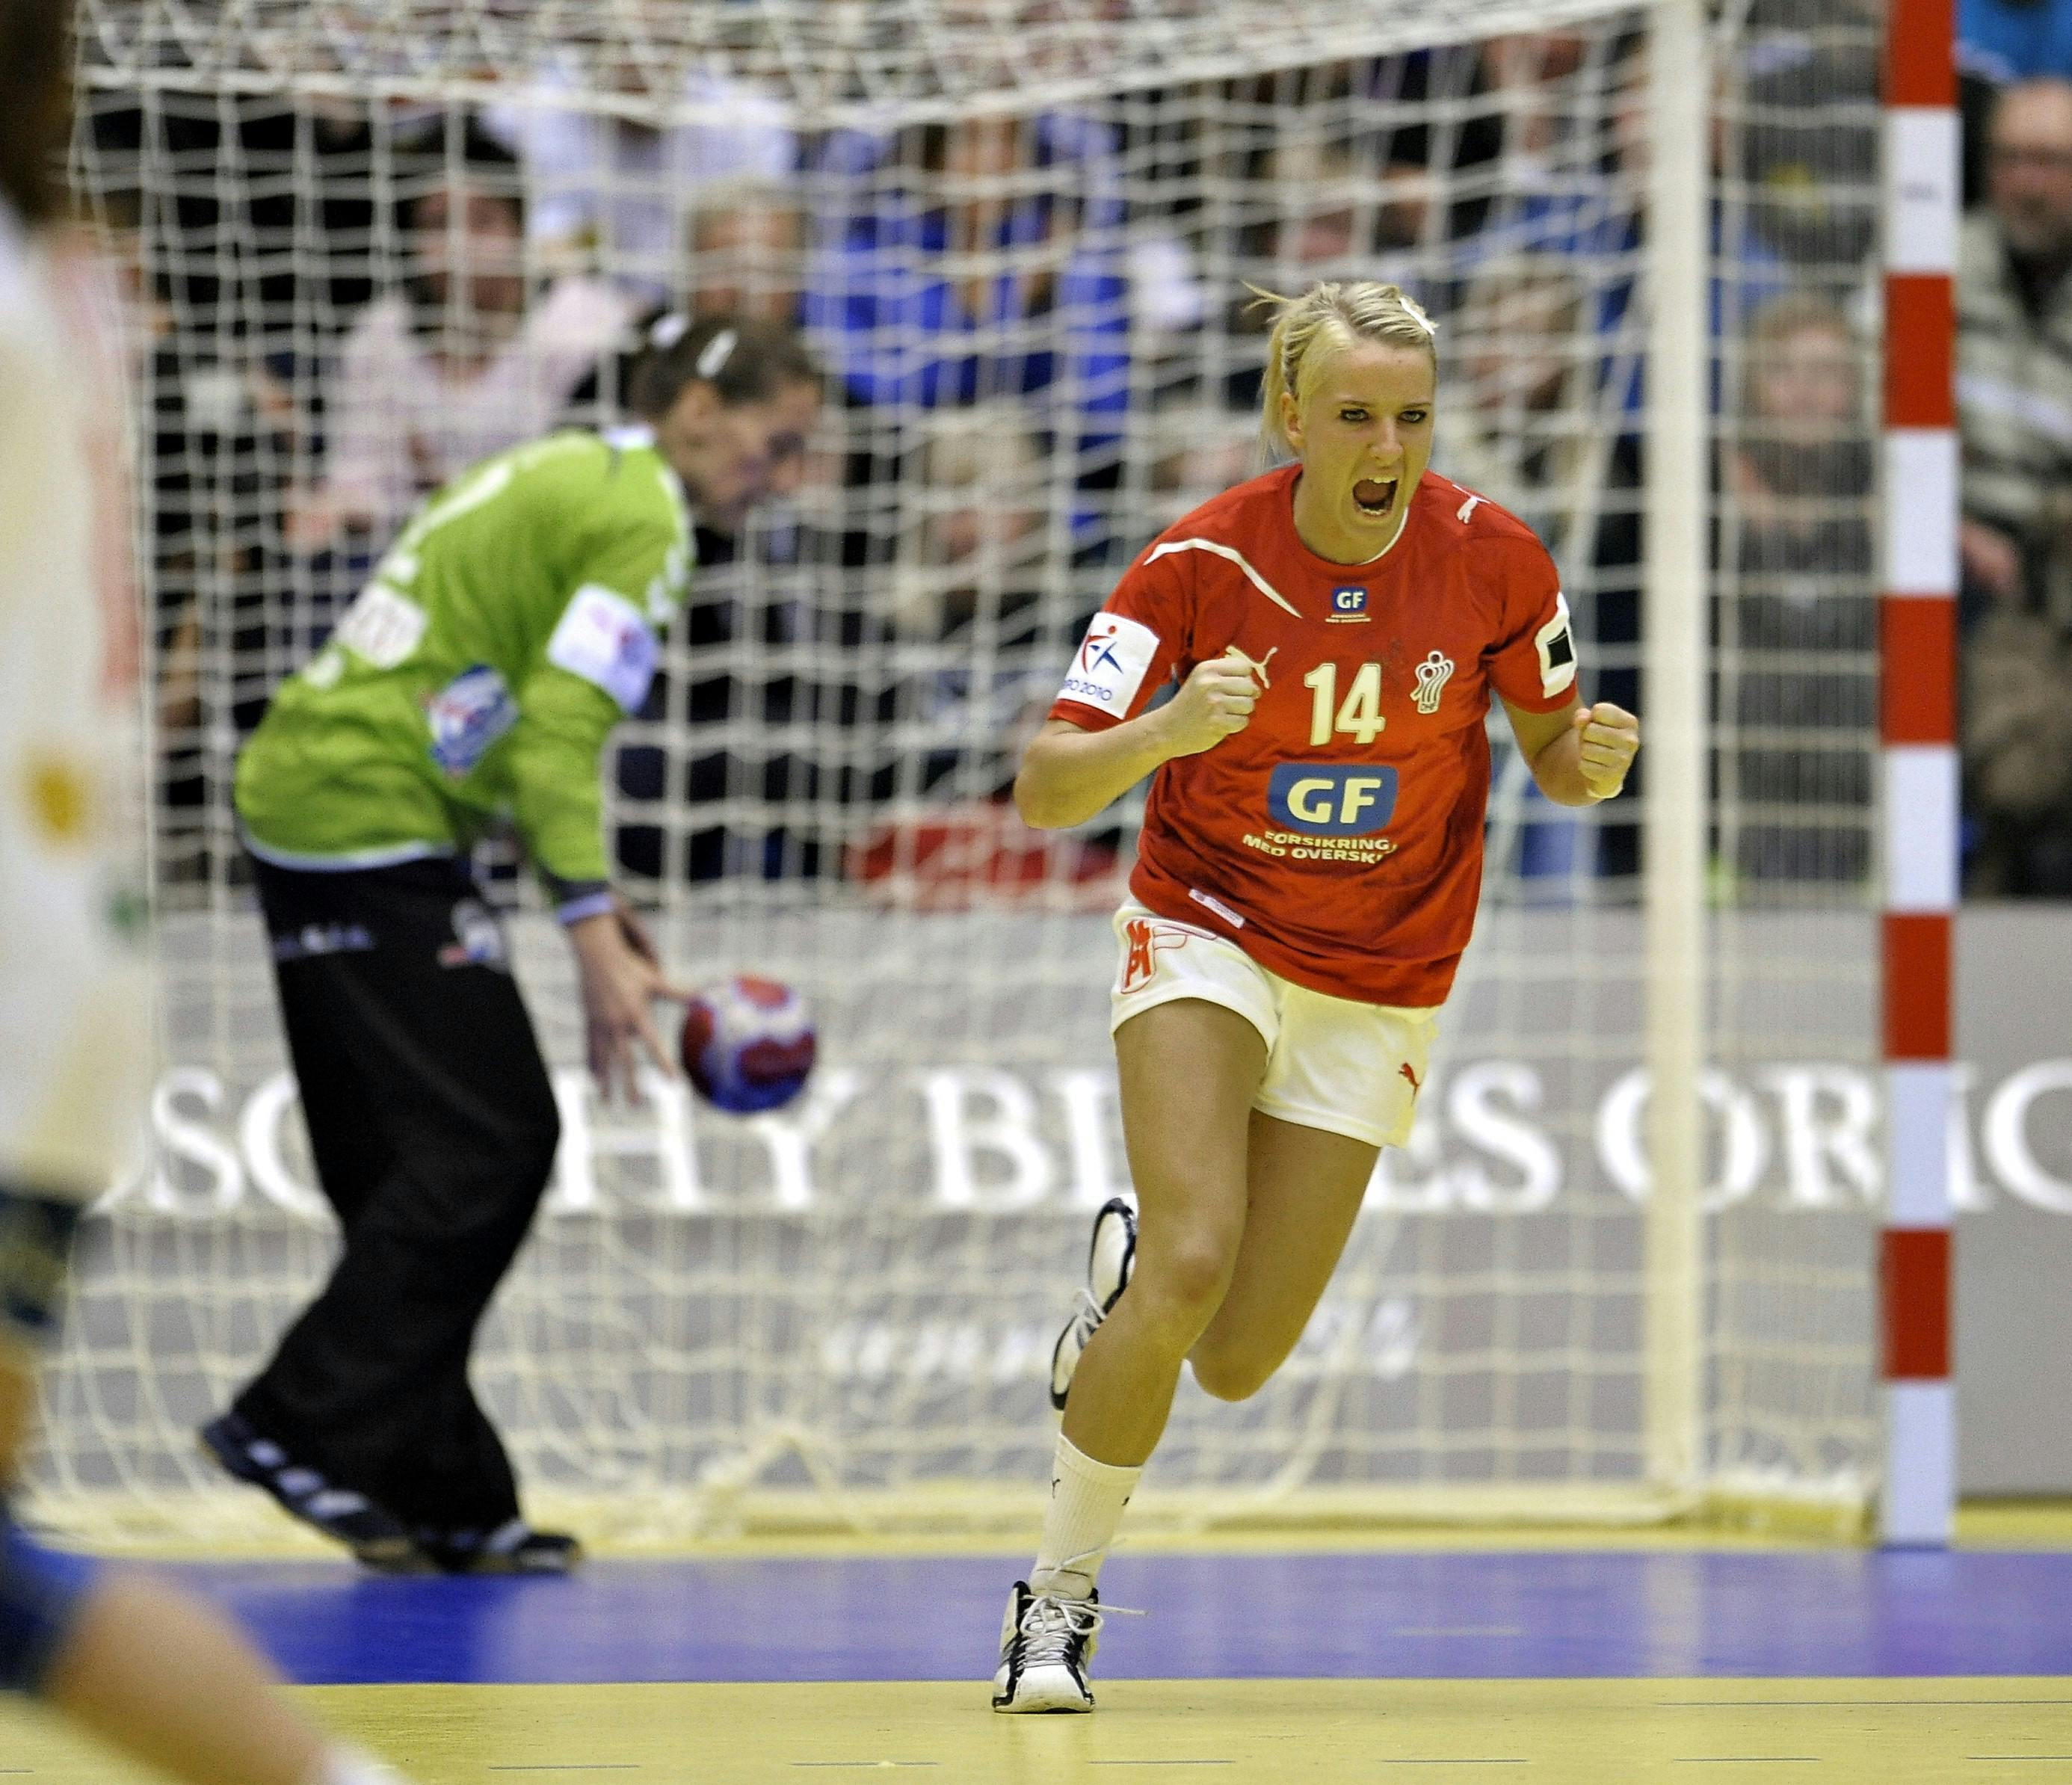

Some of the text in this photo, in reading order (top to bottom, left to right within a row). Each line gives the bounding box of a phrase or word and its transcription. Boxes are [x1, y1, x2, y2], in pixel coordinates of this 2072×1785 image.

[1336, 591, 1364, 609] GF
[1304, 662, 1387, 746] 14
[1286, 777, 1382, 824] GF
[1291, 847, 1384, 864] OVERSK
